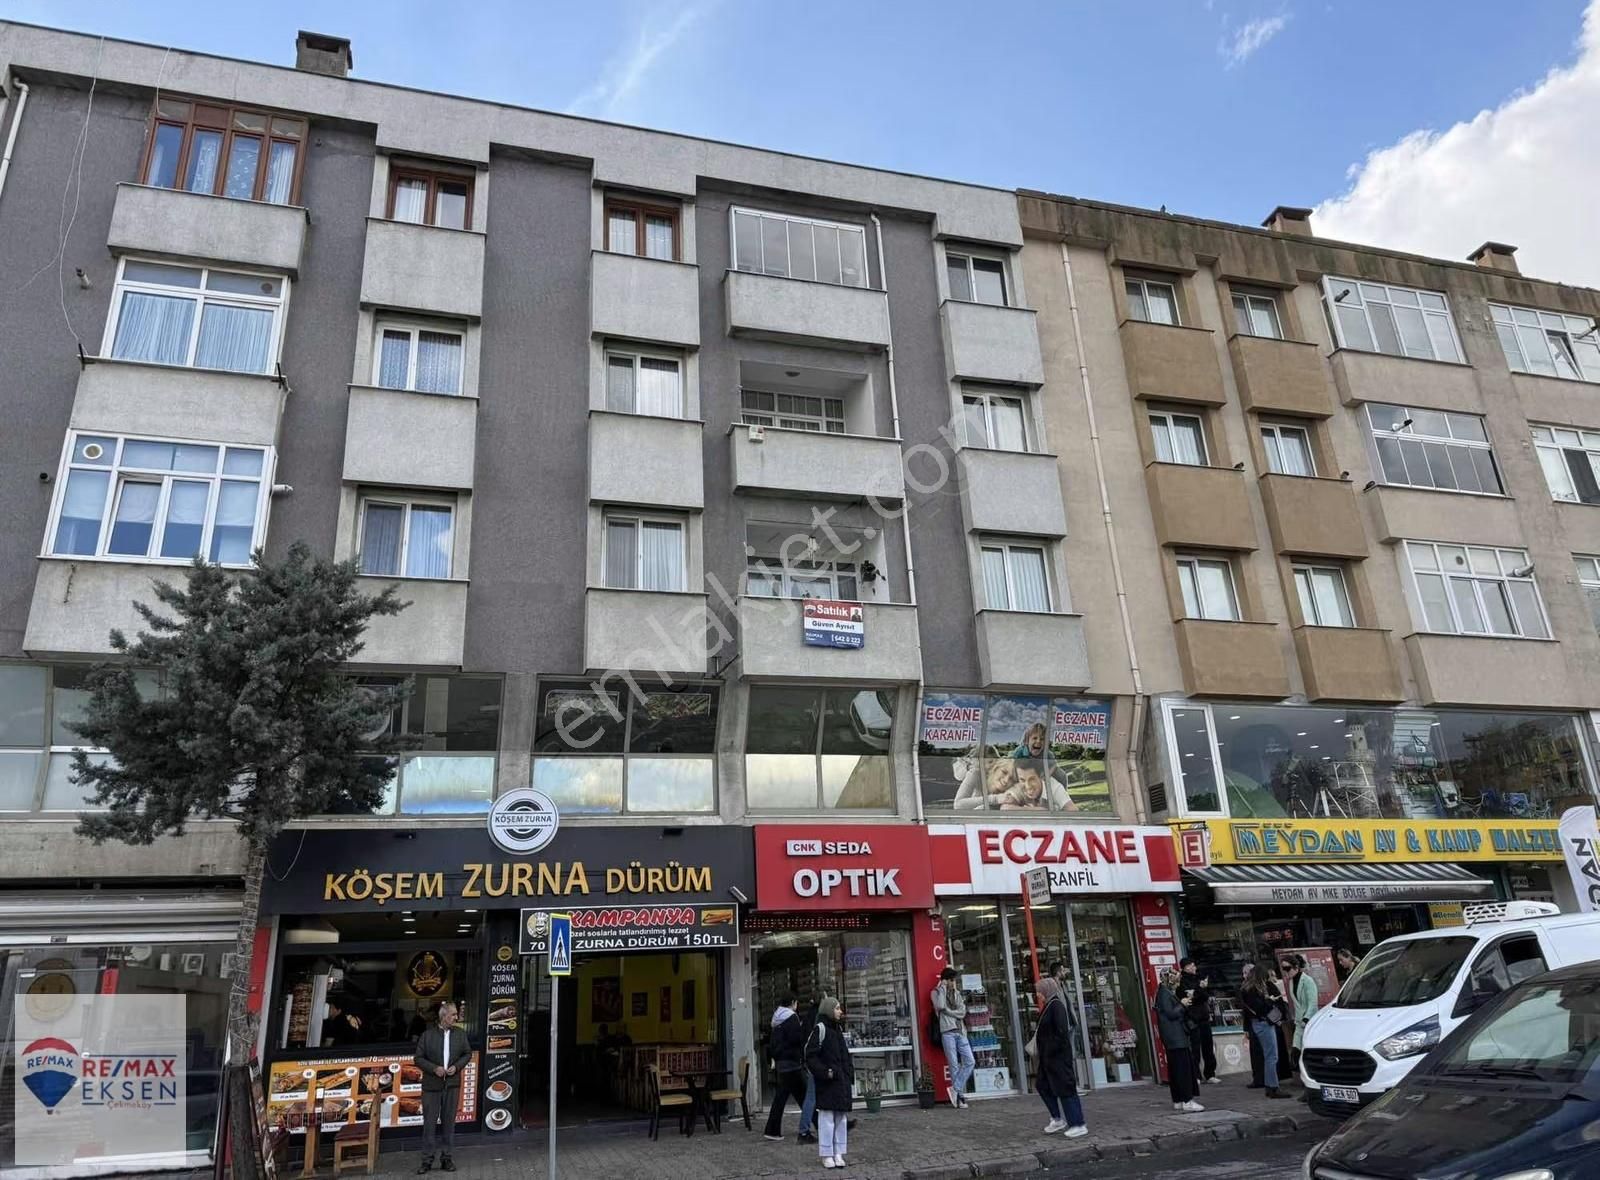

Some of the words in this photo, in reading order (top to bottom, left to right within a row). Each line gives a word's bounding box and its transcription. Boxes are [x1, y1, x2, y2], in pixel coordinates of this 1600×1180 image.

[816, 604, 849, 616] Satılık
[925, 707, 981, 722] ECZANE
[1055, 711, 1106, 726] ECZANE
[924, 725, 977, 742] KARANFİL
[1054, 730, 1102, 744] KARANFİL
[495, 814, 523, 823] KÖŞEM
[525, 815, 552, 823] ZURNA
[976, 829, 1141, 865] ECZANE
[1237, 828, 1364, 855] MEYDAN
[1374, 829, 1396, 853] AV
[1405, 829, 1421, 852] &
[1426, 829, 1483, 853] KAMP
[792, 842, 817, 853] CNK
[824, 842, 873, 856] SEDA
[324, 868, 444, 905] KÖŞEM
[461, 862, 590, 897] ZURNA
[606, 861, 713, 894] DÜRÜM
[1050, 867, 1099, 887] RANFİL
[1272, 888, 1304, 900] MEYDAN
[568, 906, 696, 929] KAMPANYA
[587, 927, 617, 937] soslarla
[530, 941, 545, 950] 70
[576, 939, 625, 949] ZURNA
[628, 936, 678, 947] DÜRÜM
[491, 963, 518, 974] KÖŞEM
[492, 974, 515, 983] ZURNA
[491, 984, 516, 995] DÜRÜM
